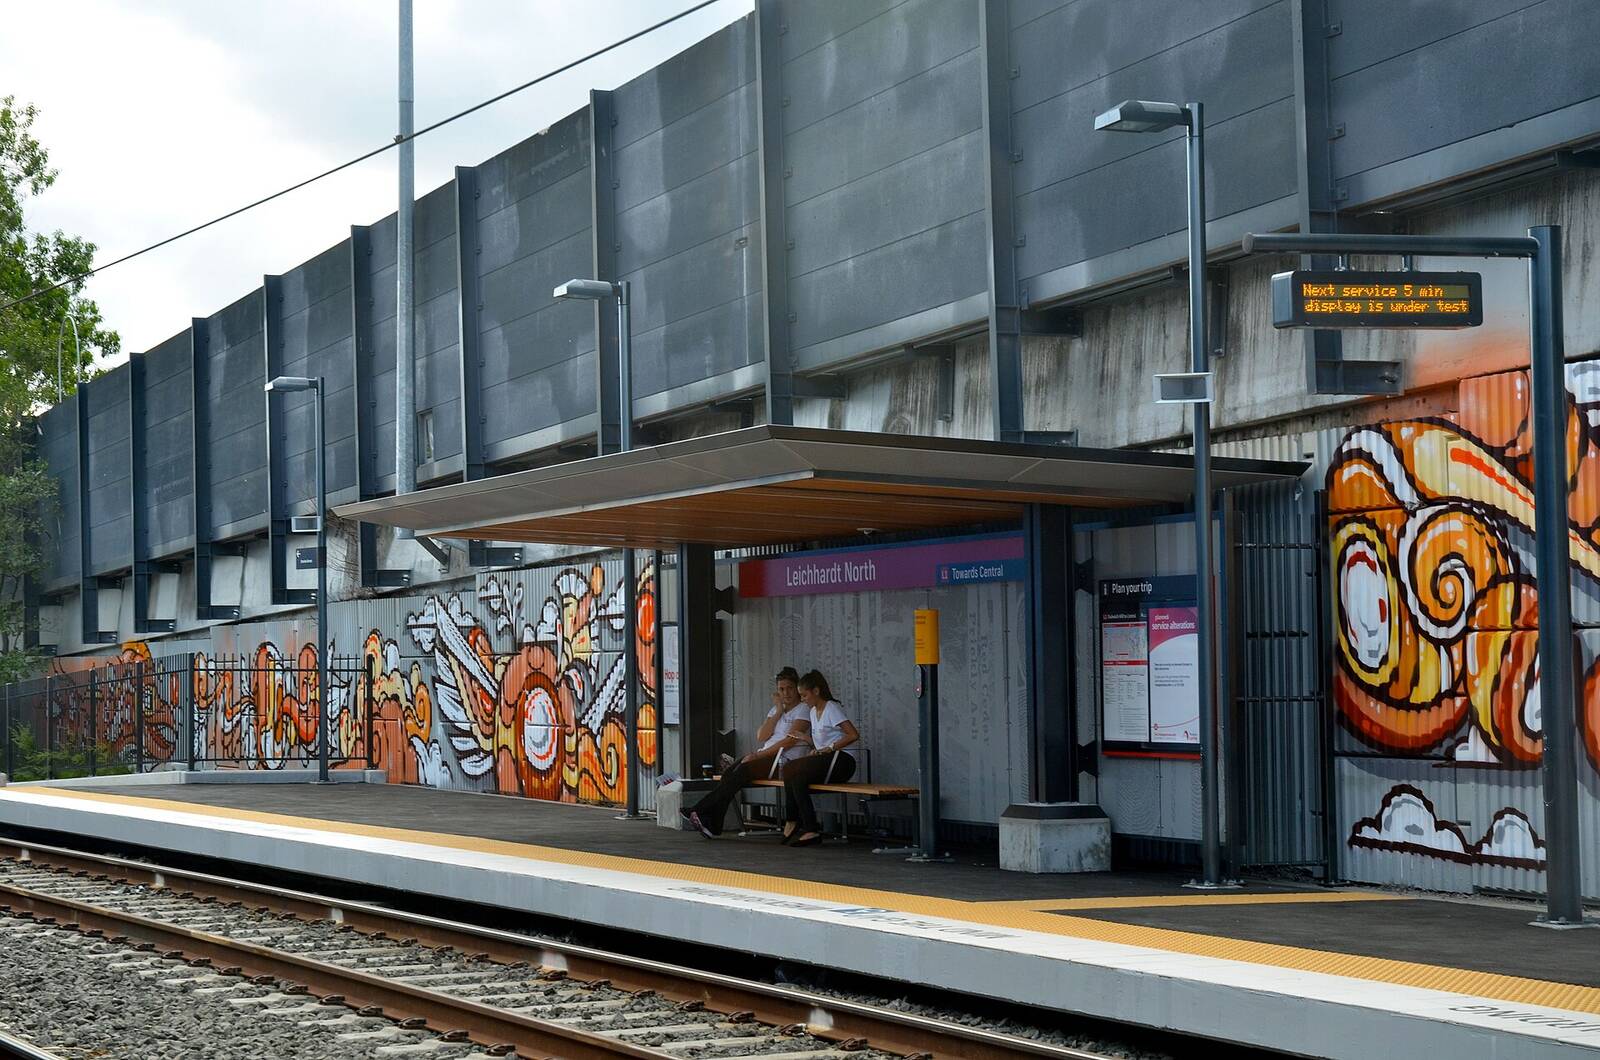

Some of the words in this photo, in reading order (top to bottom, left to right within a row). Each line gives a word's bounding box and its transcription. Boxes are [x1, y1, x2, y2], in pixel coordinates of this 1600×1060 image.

[1302, 283, 1335, 297] Next
[1342, 284, 1397, 297] service
[1403, 284, 1413, 297] 5
[1419, 284, 1443, 297] min
[1304, 300, 1361, 314] display
[1368, 300, 1384, 312] is
[1390, 300, 1429, 312] under
[1436, 300, 1469, 312] test
[786, 562, 843, 587] Leichhardt
[844, 559, 876, 582] North
[951, 567, 979, 581] Towards
[979, 564, 1004, 579] Central
[1111, 583, 1126, 594] Plan
[1126, 584, 1140, 595] your
[1140, 581, 1153, 594] trip
[1151, 620, 1169, 630] service
[1169, 620, 1196, 630] alterations
